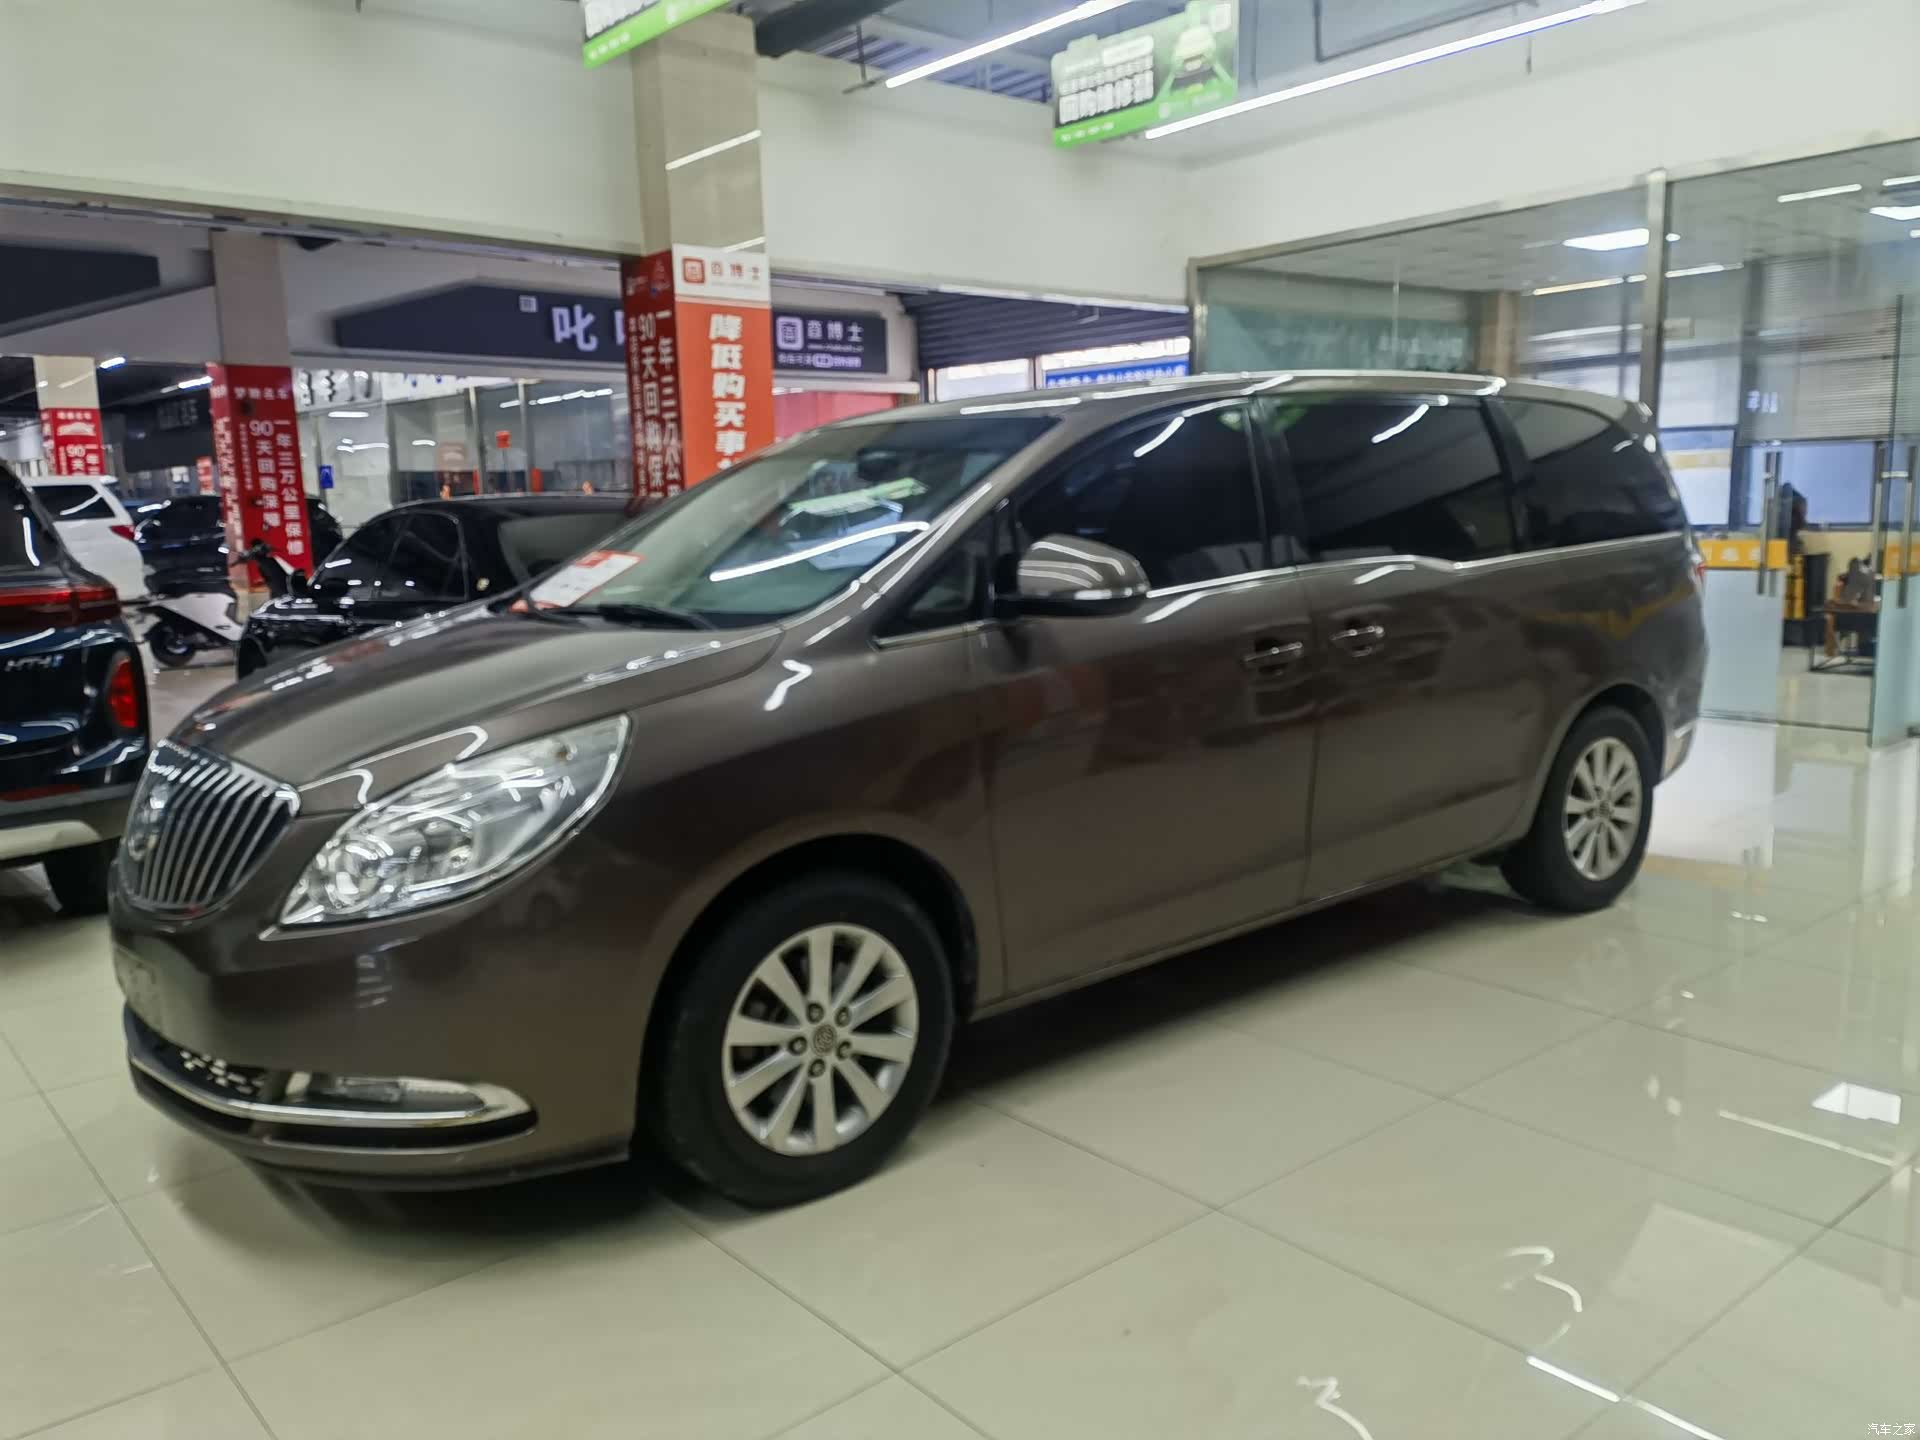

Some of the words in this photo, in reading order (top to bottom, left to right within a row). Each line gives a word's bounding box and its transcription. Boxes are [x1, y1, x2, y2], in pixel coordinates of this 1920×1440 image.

[638, 311, 665, 498] 90天回购保
[708, 313, 747, 470] 降低购买事
